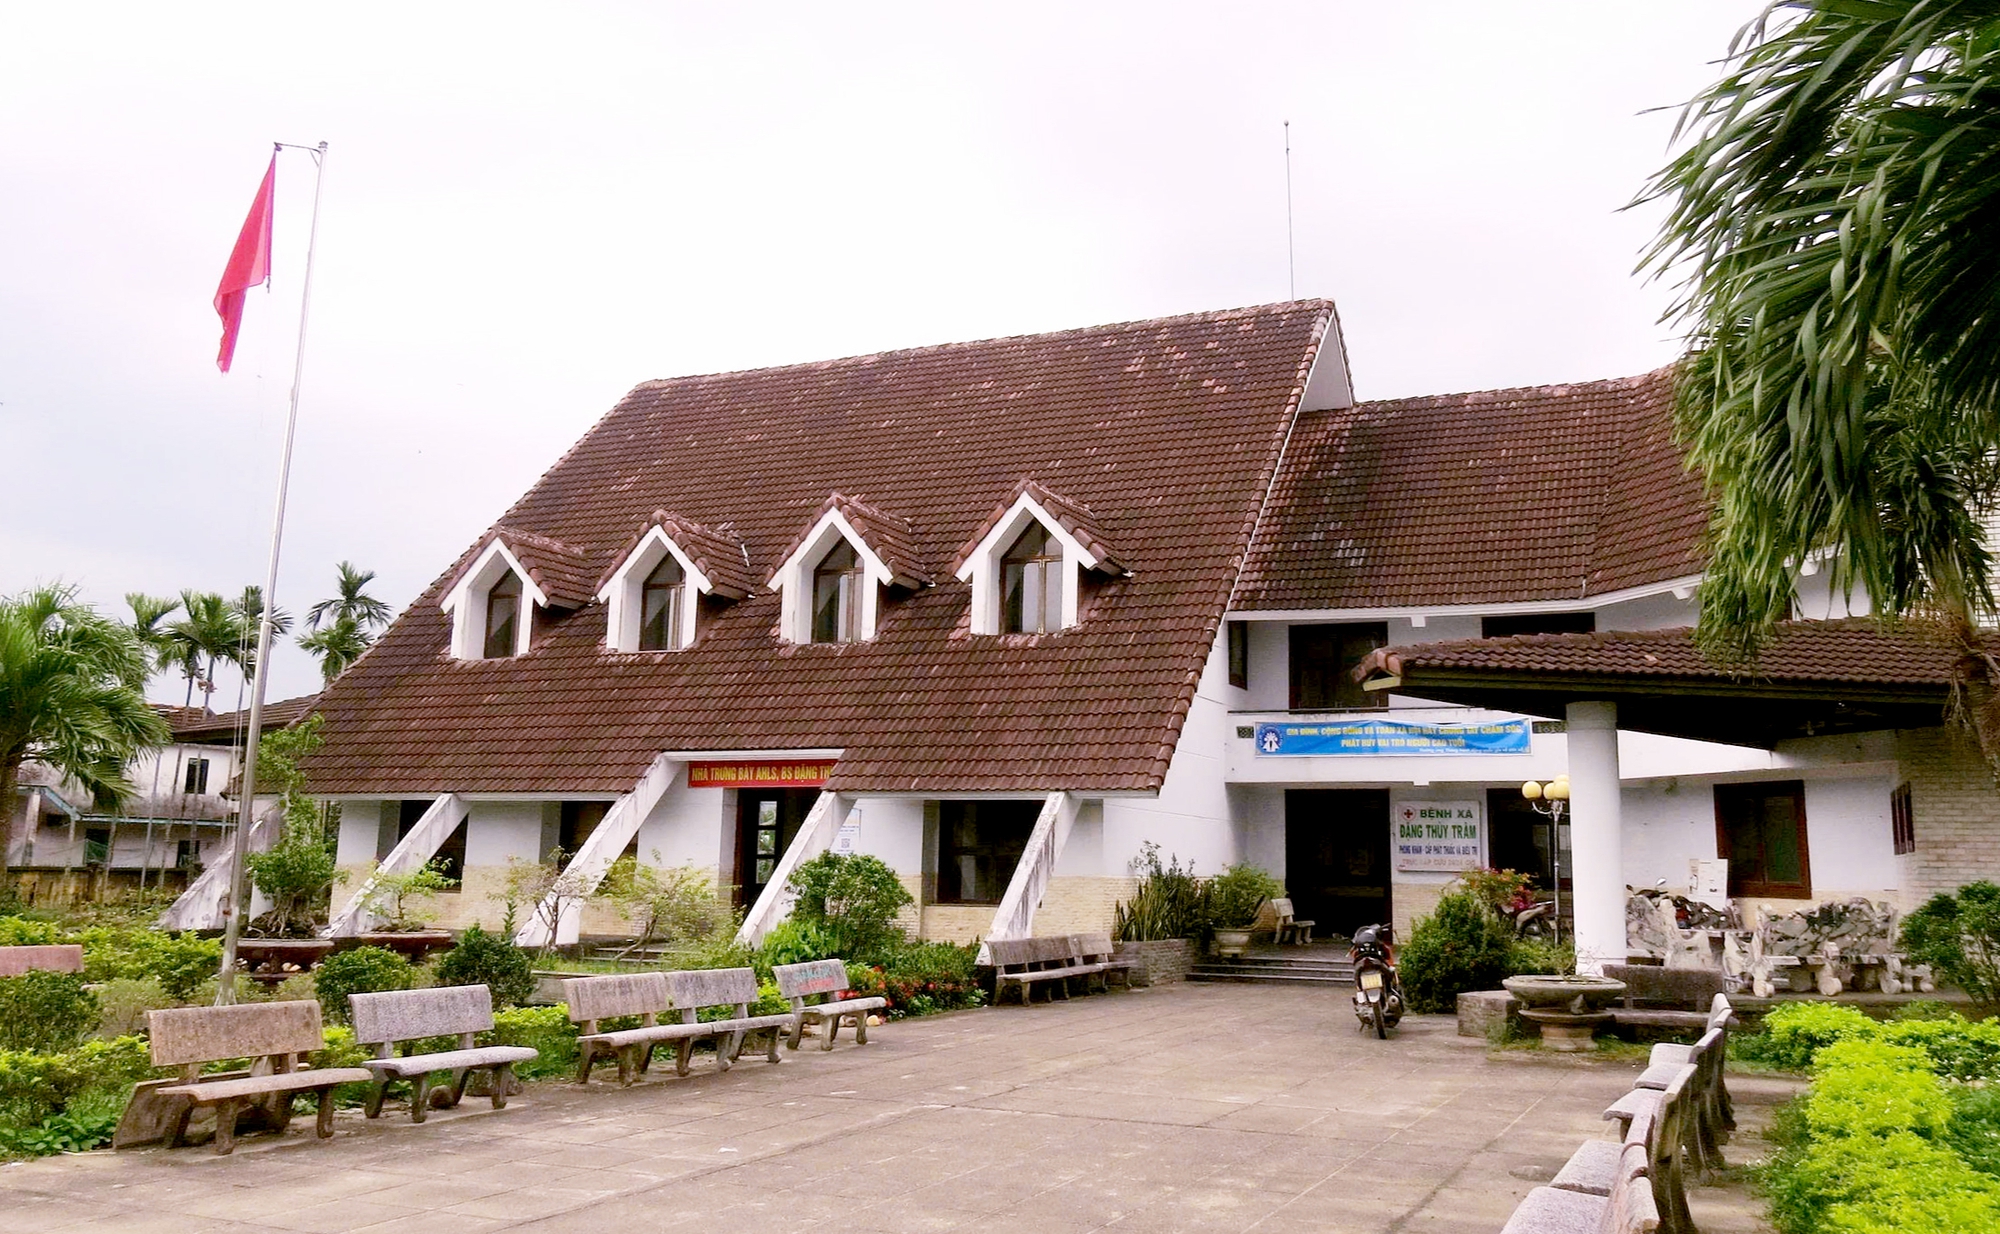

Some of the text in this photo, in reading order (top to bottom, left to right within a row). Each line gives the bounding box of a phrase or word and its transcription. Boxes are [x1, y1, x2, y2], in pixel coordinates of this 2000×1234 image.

[1341, 738, 1360, 748] PHÁT
[692, 764, 708, 781] NHÀ
[711, 766, 737, 781] TRƯNG
[738, 764, 755, 780] BÀY
[756, 766, 780, 782] AHLS,
[781, 766, 792, 780] BS
[795, 763, 818, 783] ĐẶNG
[1420, 807, 1452, 820] BỆNH
[1400, 821, 1476, 841] ĐẶNG THÙY TRÂM
